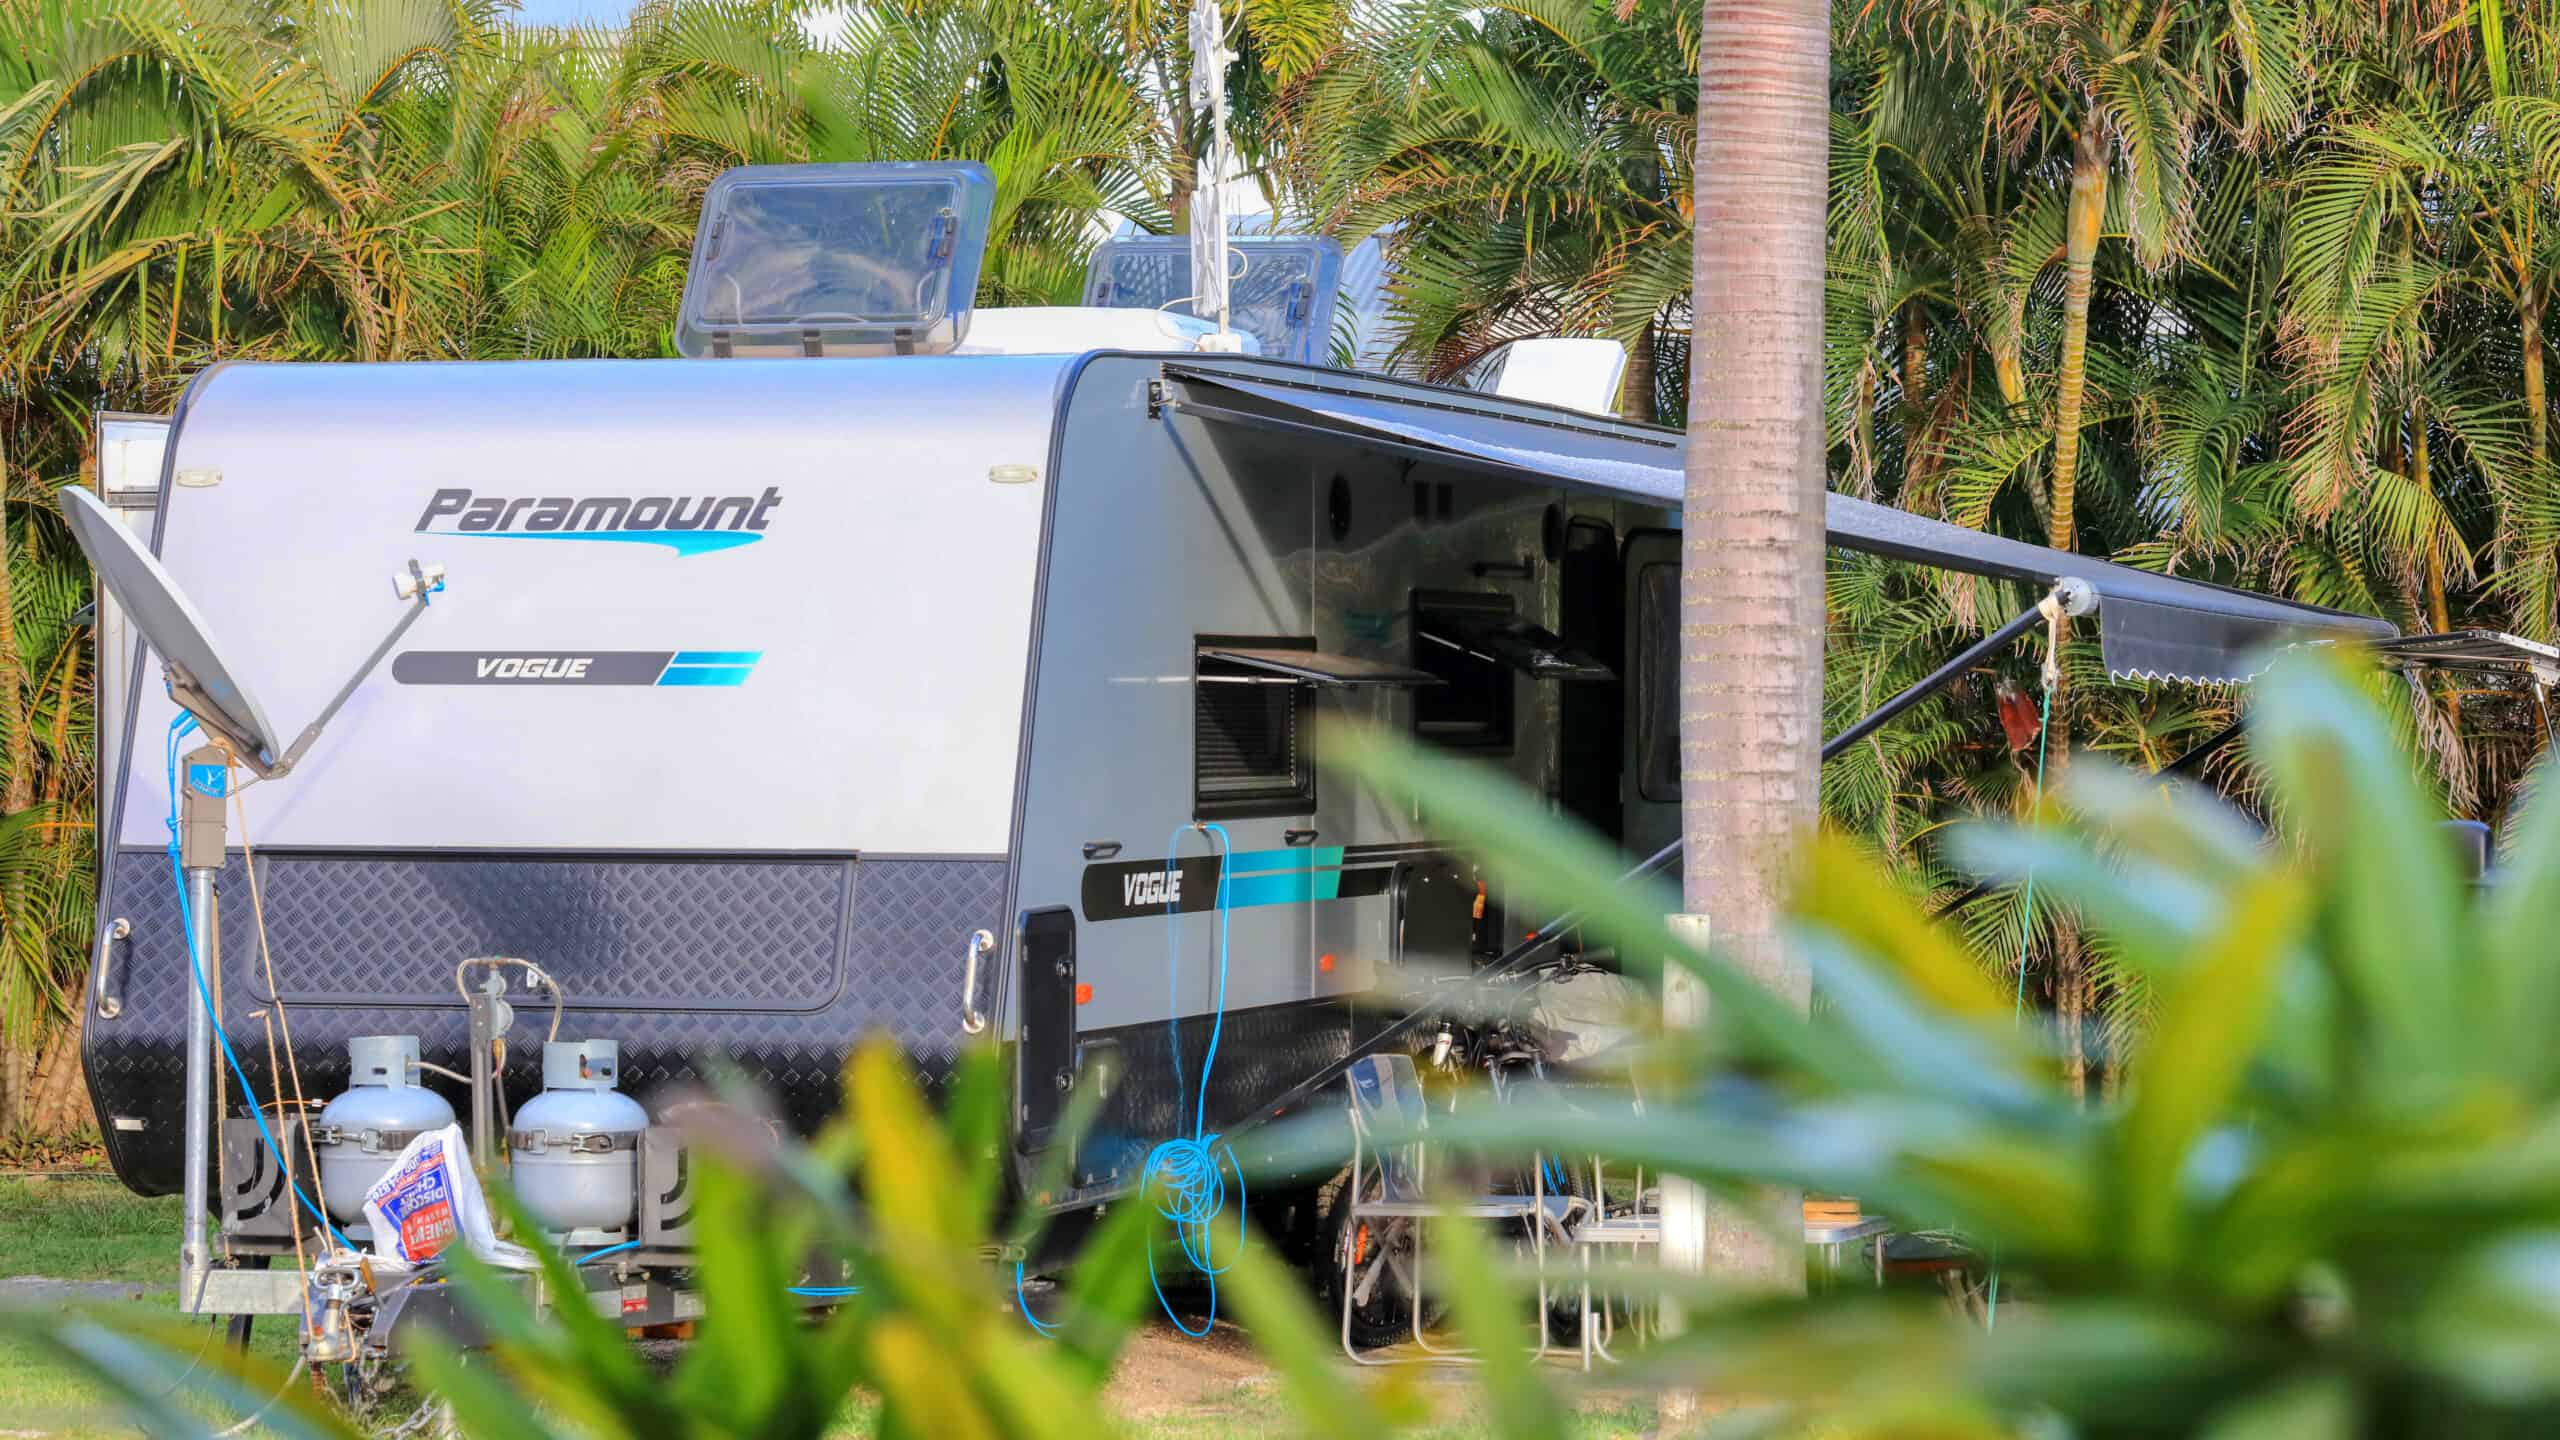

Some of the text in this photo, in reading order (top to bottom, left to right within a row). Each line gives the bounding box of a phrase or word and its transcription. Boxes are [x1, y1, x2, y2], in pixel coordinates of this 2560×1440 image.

[414, 486, 783, 532] Paramount
[476, 657, 593, 679] VOGUE
[1124, 870, 1184, 906] VOGUE
